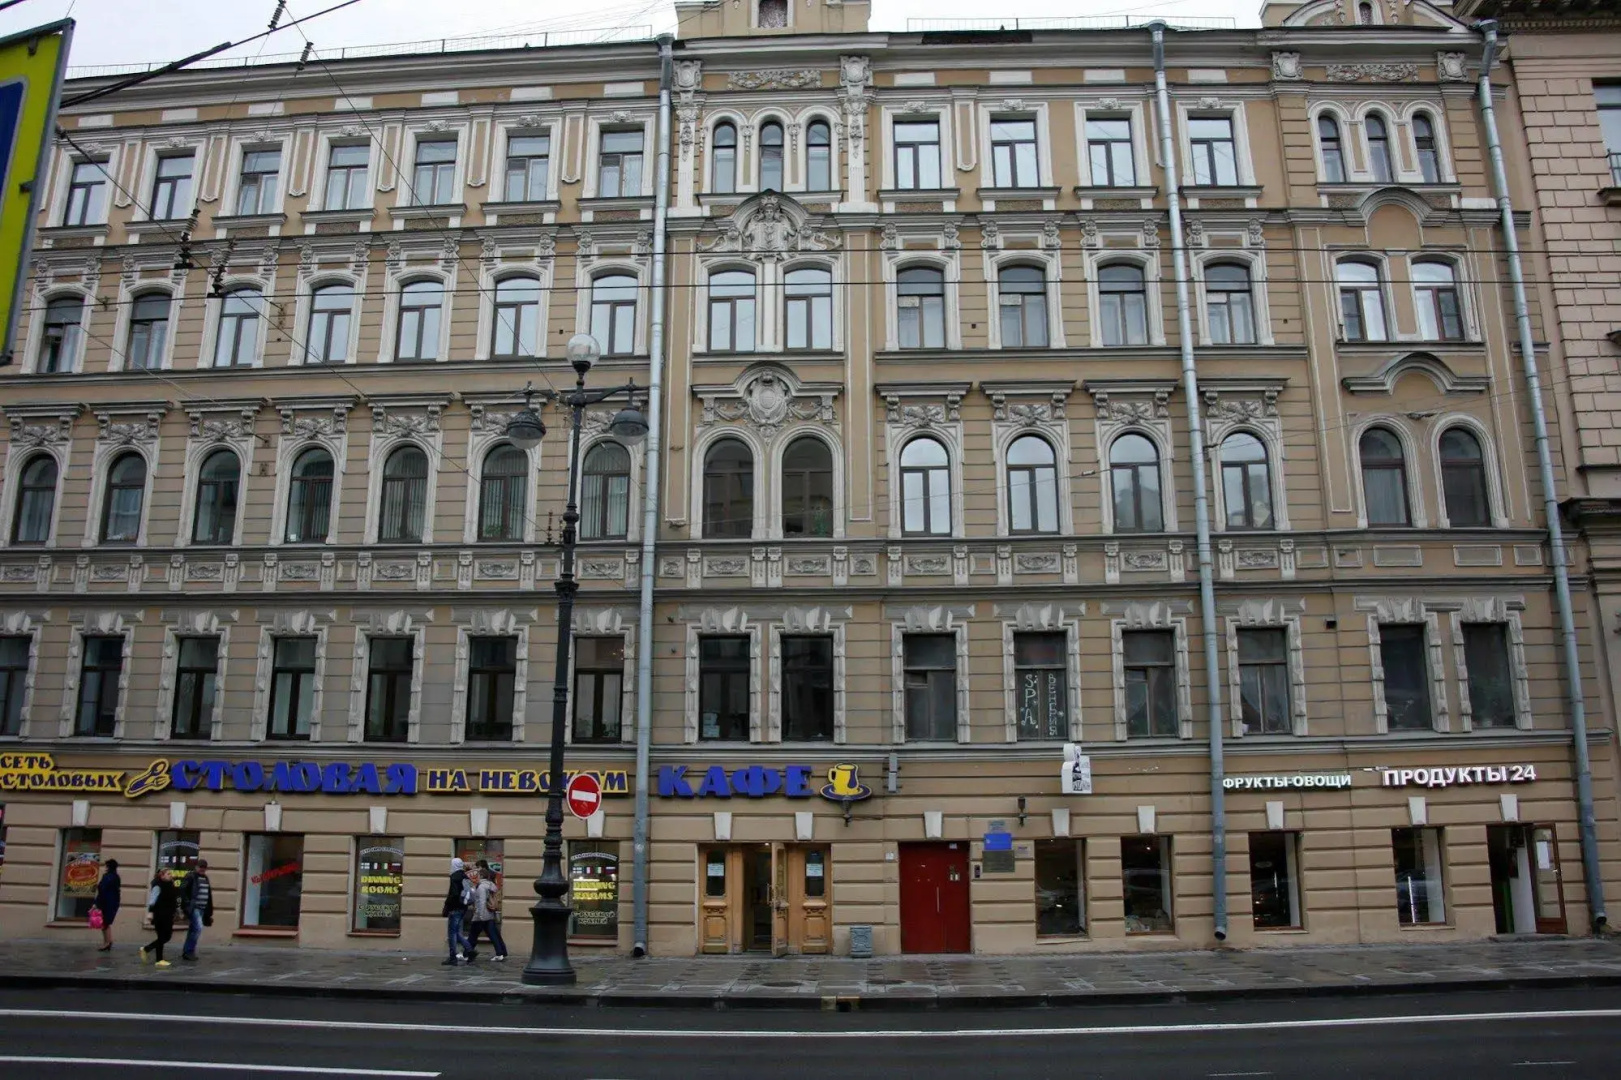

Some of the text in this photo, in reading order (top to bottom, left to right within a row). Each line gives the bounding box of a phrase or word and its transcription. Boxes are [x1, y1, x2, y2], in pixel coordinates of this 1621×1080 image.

[1021, 674, 1037, 726] SPA
[0, 756, 51, 769] СЕТЬ
[3, 772, 118, 788] СТОЛОВЫХ
[171, 760, 418, 794] СТОЛОВАЯ
[428, 769, 628, 793] НА НЕВСКМ
[657, 765, 814, 797] КАФЕ
[1222, 774, 1352, 789] ФРУКТЫ-ОВОЩИ
[1382, 764, 1537, 788] ПРОДУКТЫ 24
[361, 886, 399, 894] ROOMS
